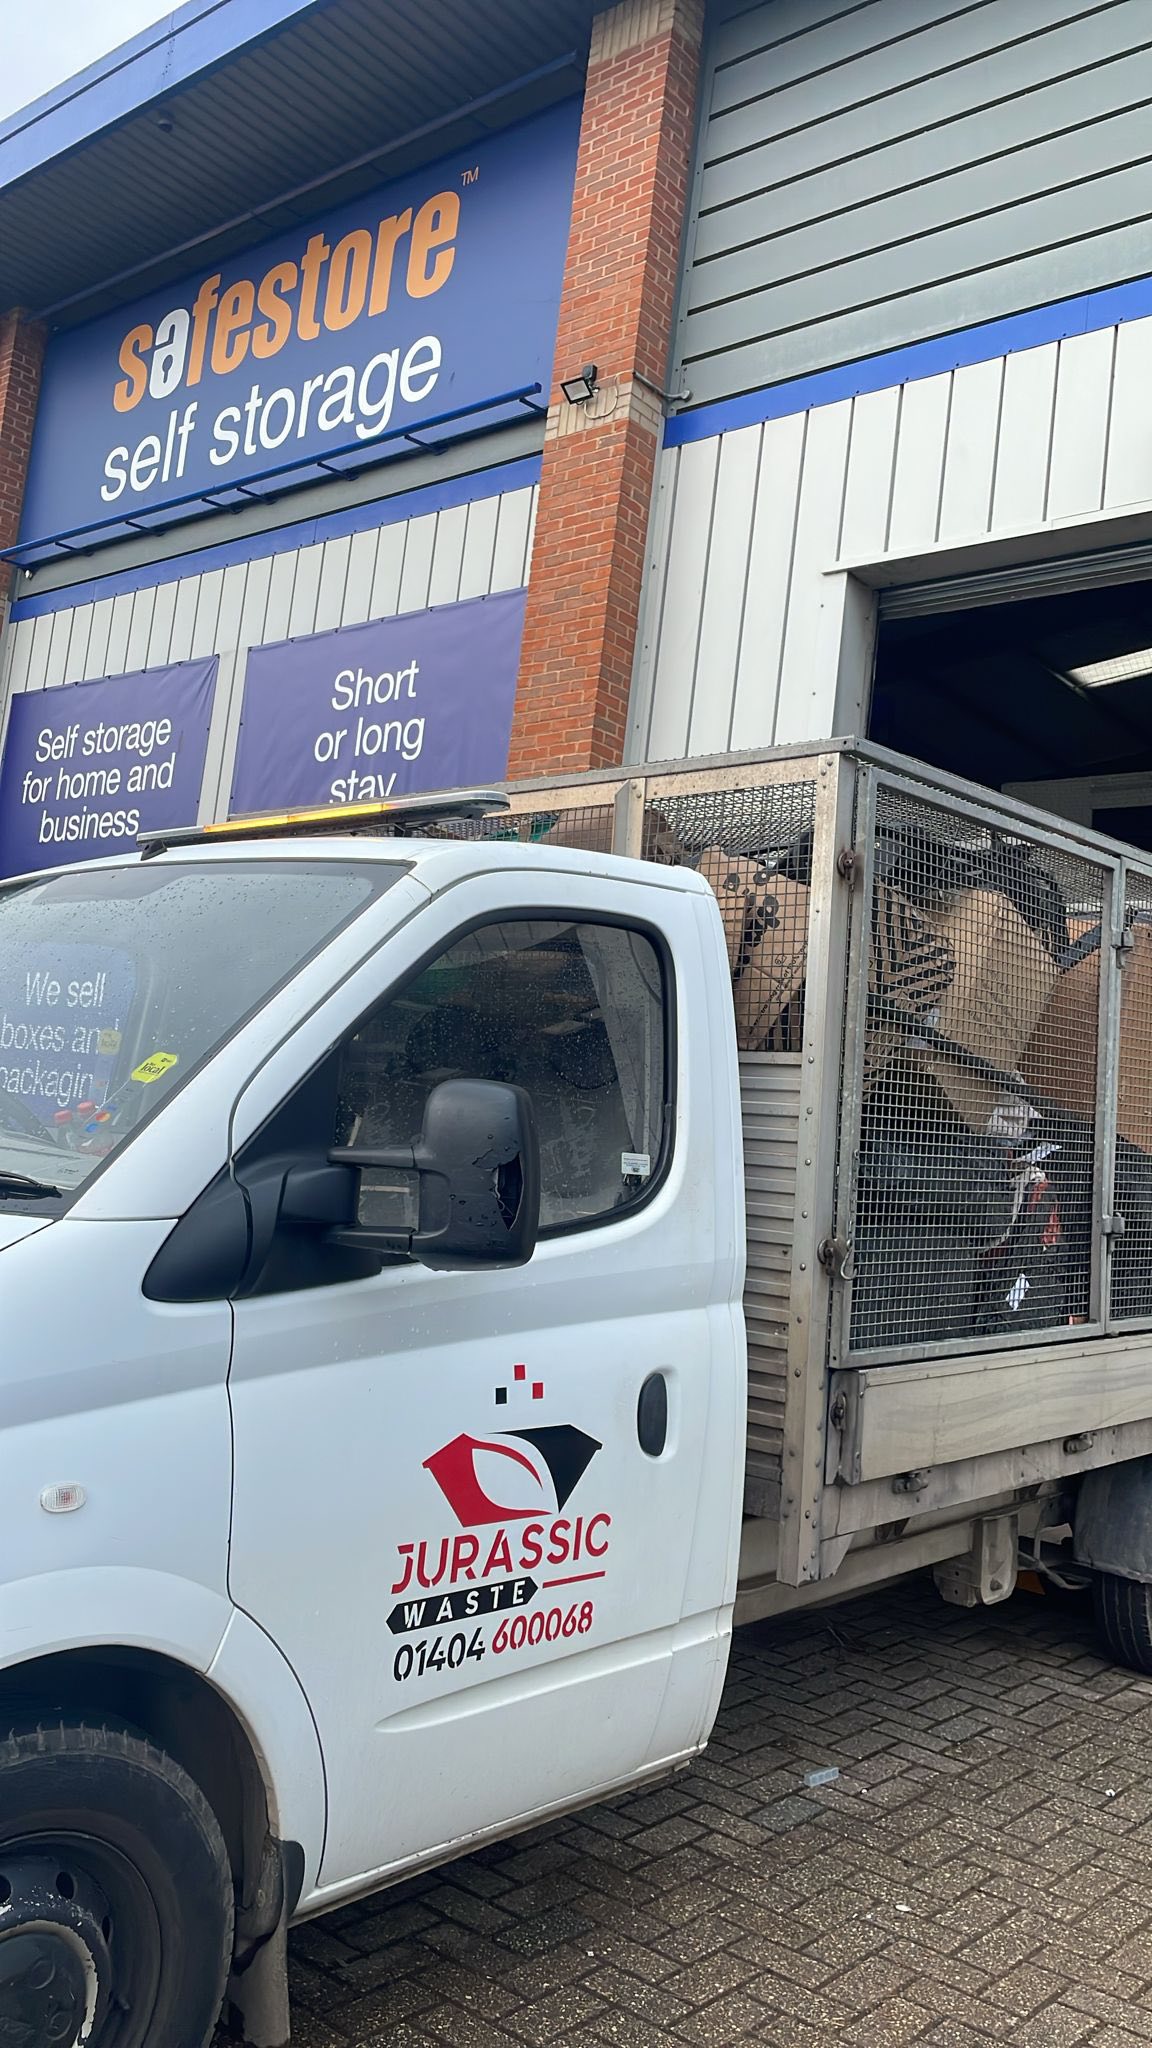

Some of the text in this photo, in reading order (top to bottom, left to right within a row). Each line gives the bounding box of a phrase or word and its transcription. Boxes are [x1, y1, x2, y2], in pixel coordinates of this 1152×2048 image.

[113, 190, 461, 413] safestore
[101, 335, 442, 502] self storage
[331, 660, 419, 711] Short
[36, 717, 172, 764] Self storage
[314, 716, 425, 762] or long
[22, 753, 174, 805] for home and
[38, 807, 140, 844] business
[26, 971, 106, 1007] We sell
[0, 1014, 65, 1052] boxes
[72, 1018, 119, 1055] an
[391, 1513, 612, 1595] JURASSIC
[403, 1580, 526, 1629] WASTE
[393, 1600, 593, 1682] 01404 600068
